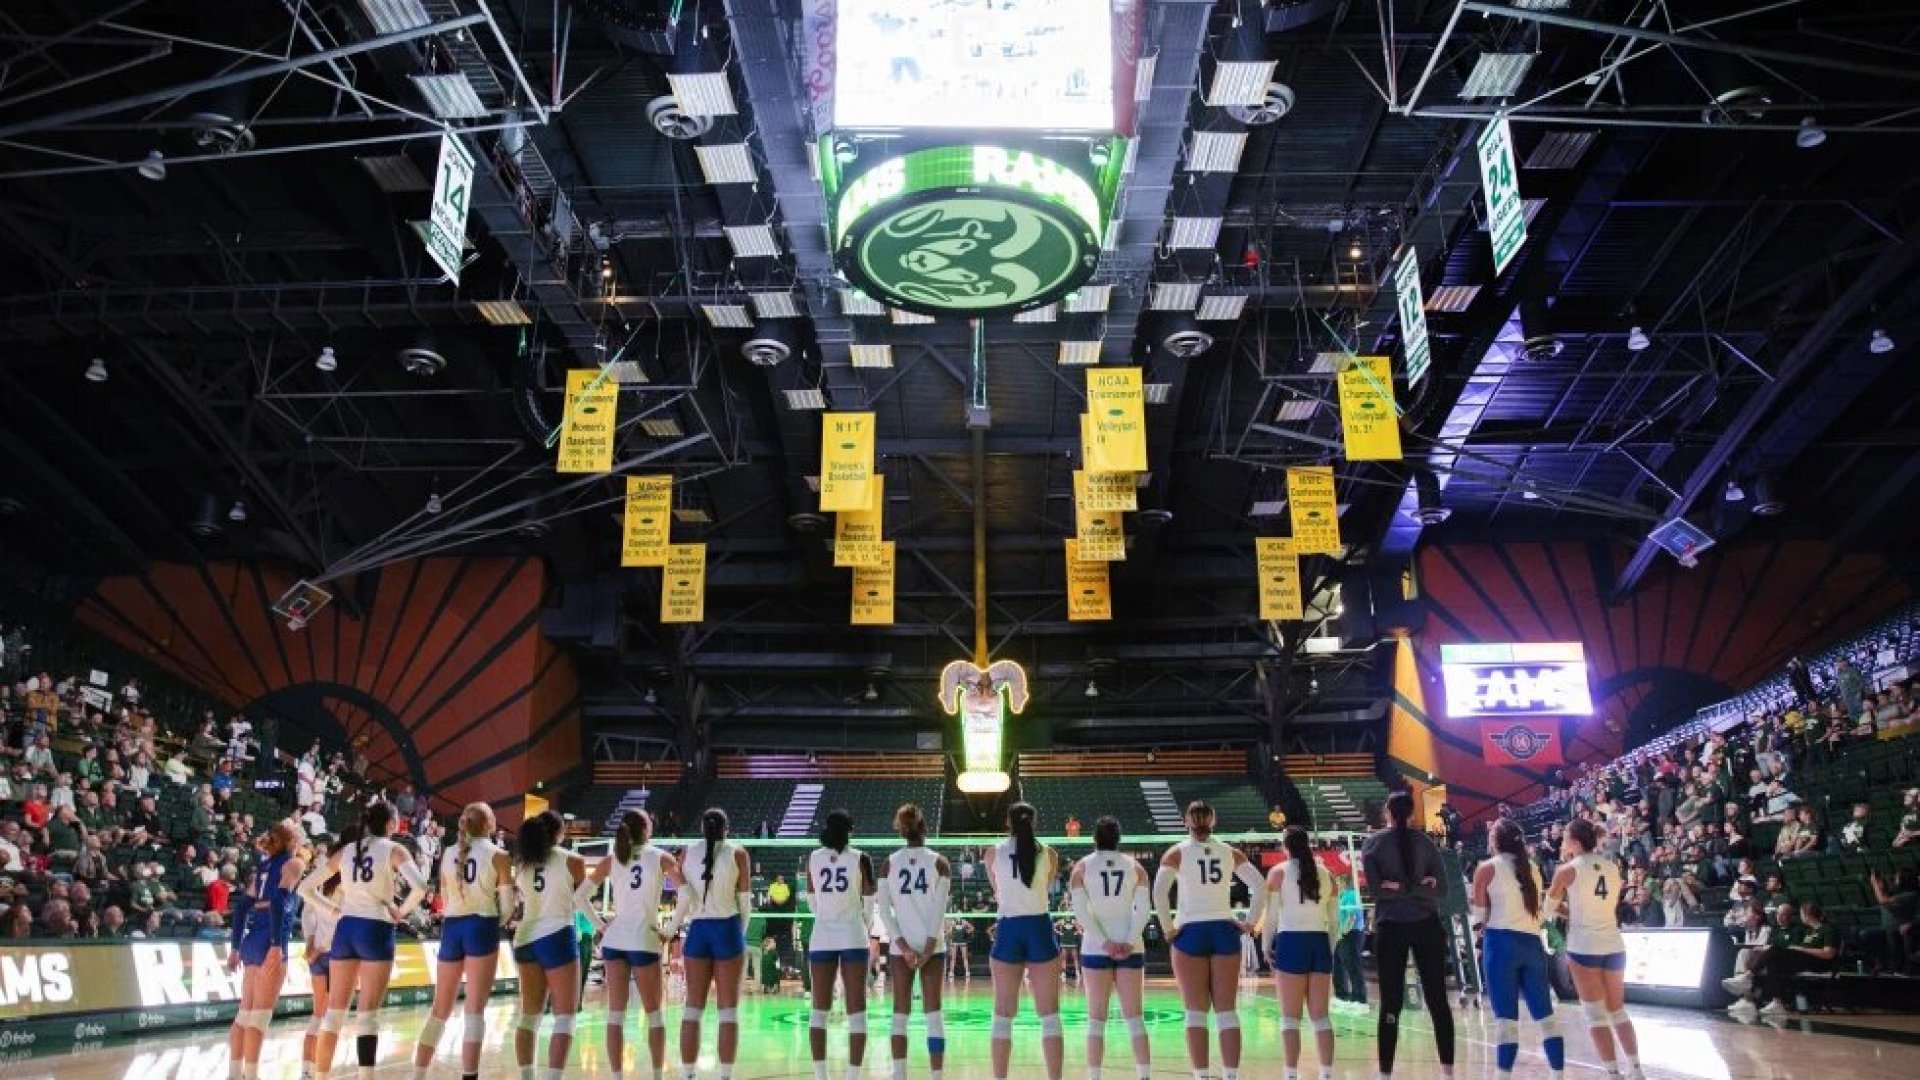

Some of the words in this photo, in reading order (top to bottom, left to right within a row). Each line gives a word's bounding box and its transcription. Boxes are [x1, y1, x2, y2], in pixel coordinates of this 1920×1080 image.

[1488, 149, 1513, 209] 24
[443, 163, 466, 223] 14
[1403, 286, 1419, 331] 12
[1099, 376, 1130, 386] NCAA
[1090, 390, 1141, 399] Tournament
[1097, 421, 1137, 433] Volleyball
[533, 867, 546, 892] 5
[630, 865, 643, 890] 3
[820, 867, 849, 893] 25
[899, 868, 929, 894] 24
[1100, 871, 1125, 897] 17
[1196, 859, 1223, 885] 15
[1593, 875, 1609, 900] 4
[0, 952, 75, 1004] MS
